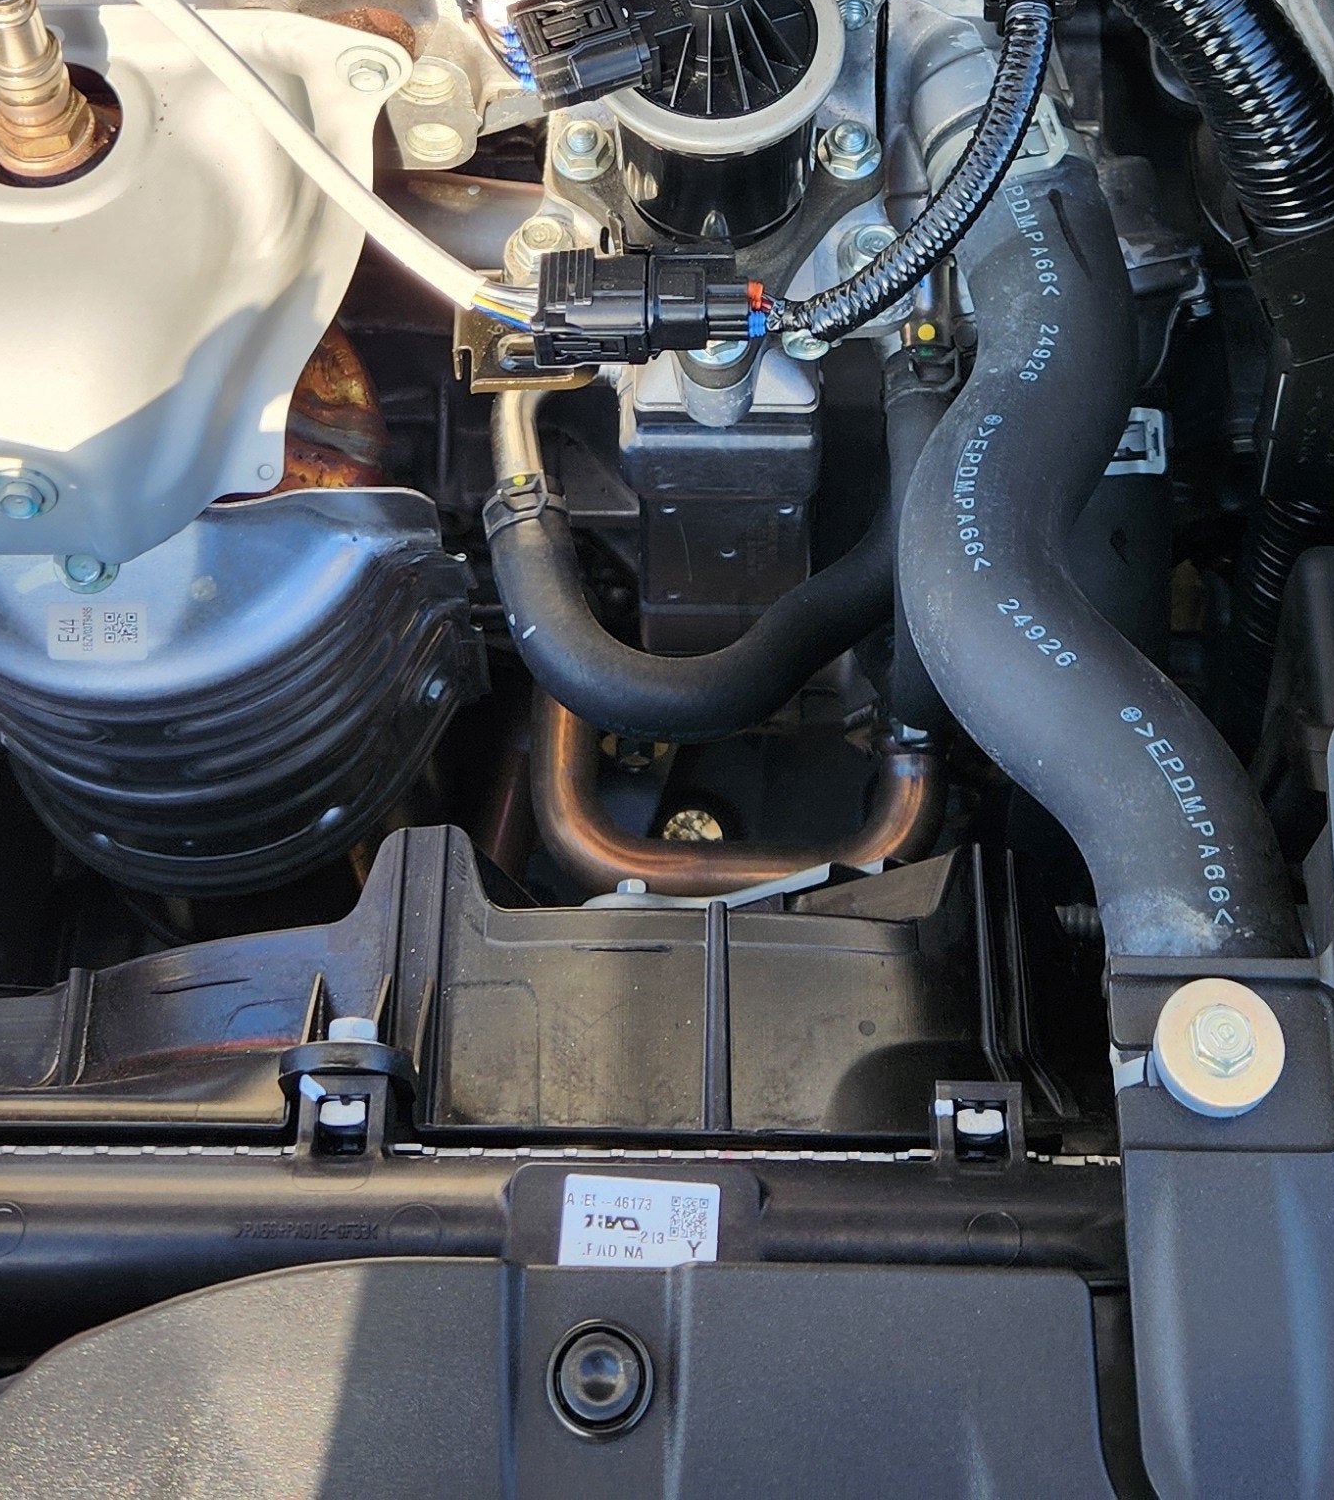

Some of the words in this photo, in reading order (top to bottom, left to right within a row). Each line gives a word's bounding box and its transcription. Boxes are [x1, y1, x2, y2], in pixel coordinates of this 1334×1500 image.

[1019, 323, 1059, 382] 24926
[58, 619, 79, 642] E44
[997, 598, 1077, 668] 24926
